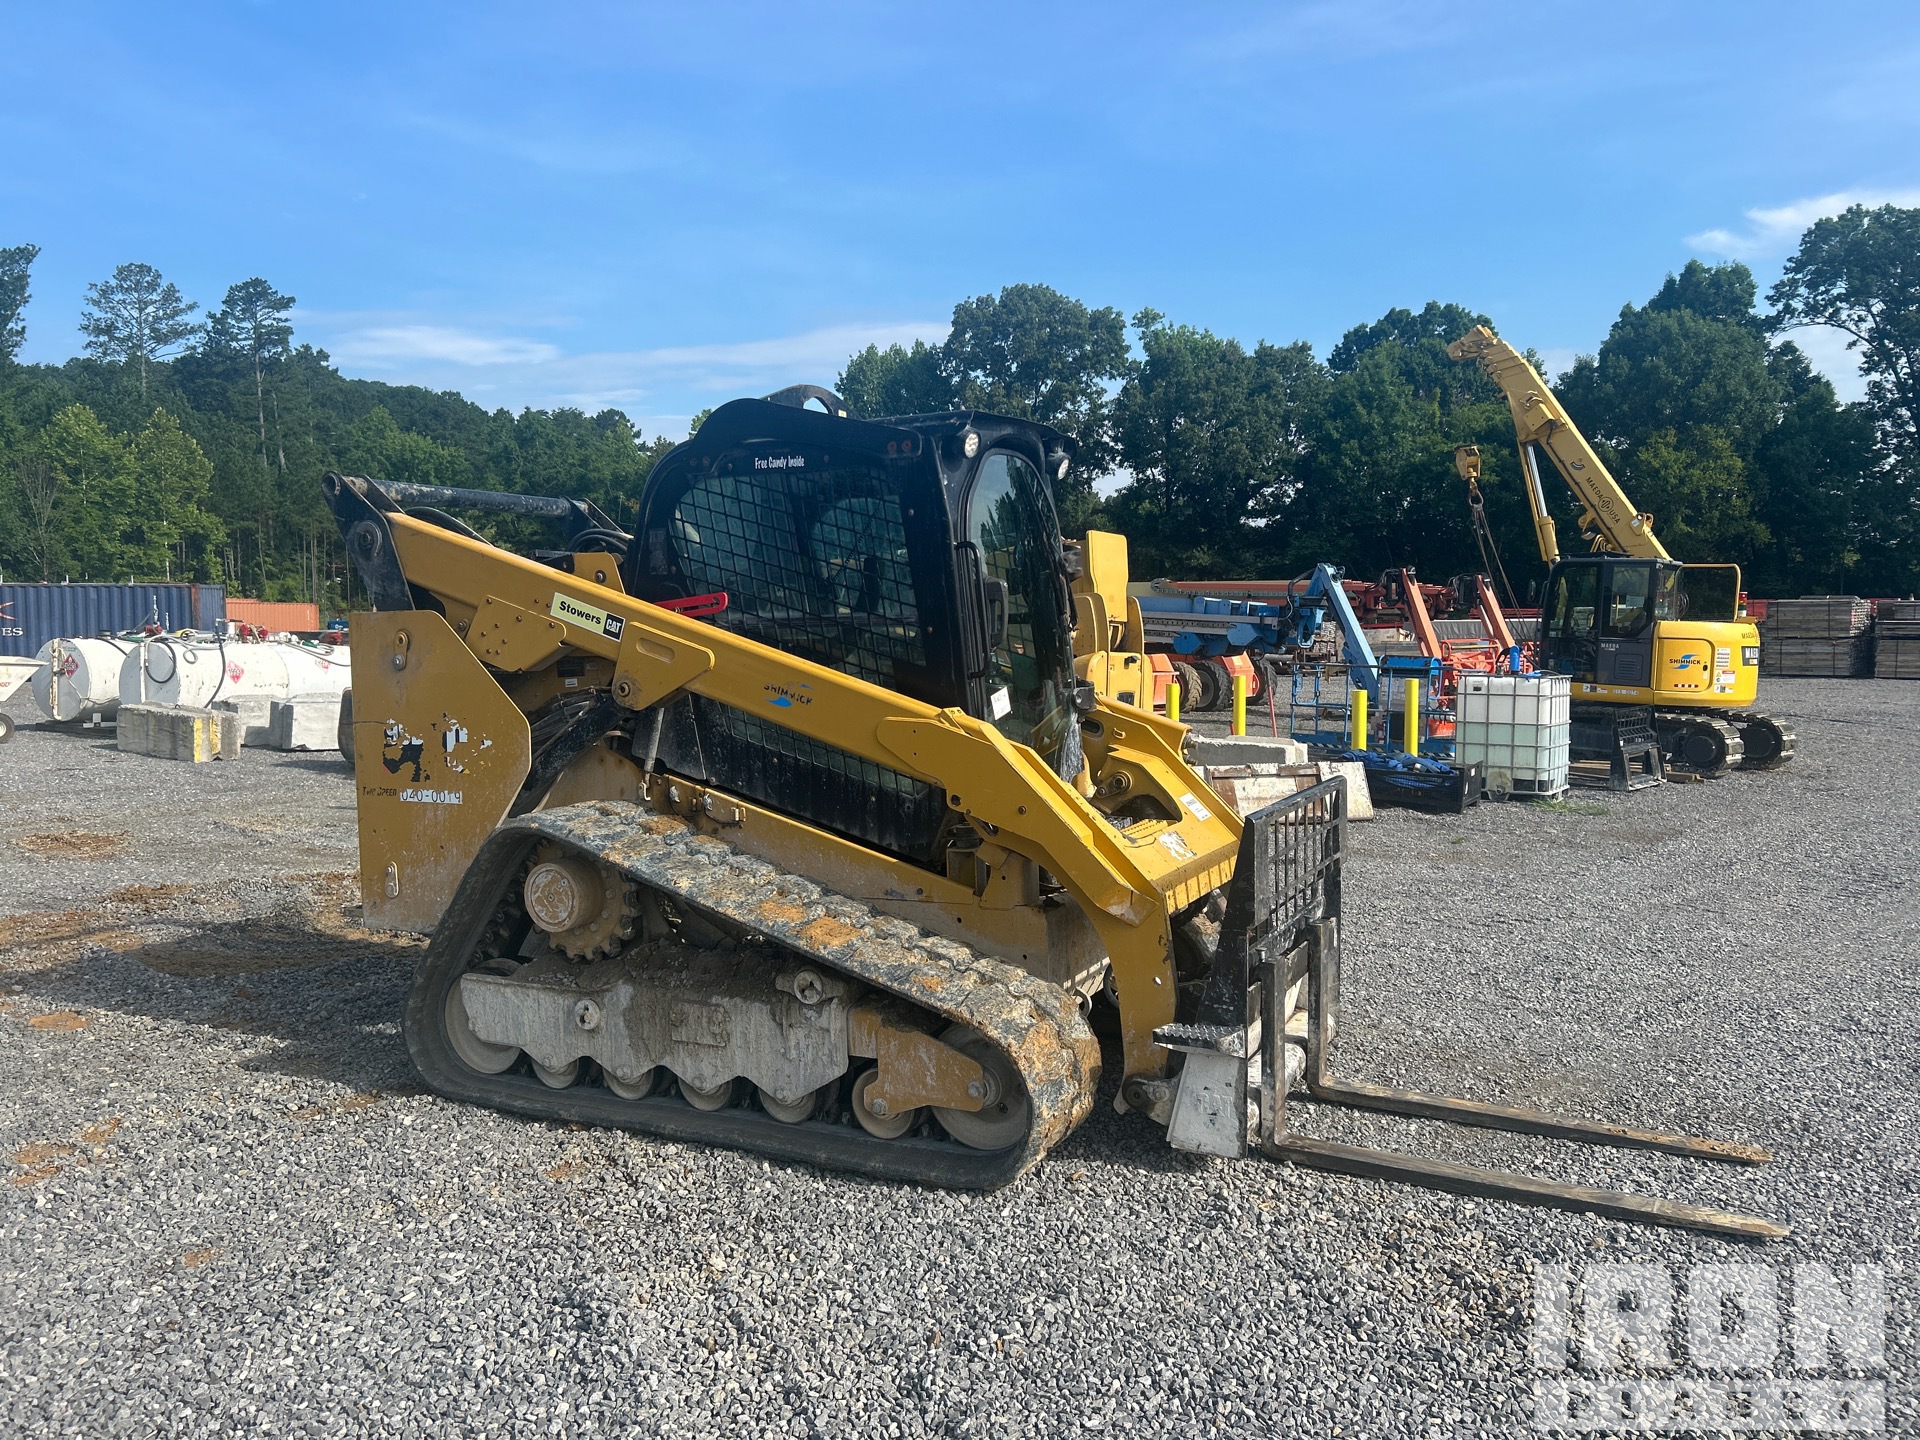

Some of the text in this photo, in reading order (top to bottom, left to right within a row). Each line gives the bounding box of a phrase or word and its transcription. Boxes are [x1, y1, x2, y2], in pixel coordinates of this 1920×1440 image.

[755, 455, 805, 470] Free Candy Inside
[1586, 477, 1621, 524] MAEDA USA
[559, 601, 621, 633] Stowers CAT
